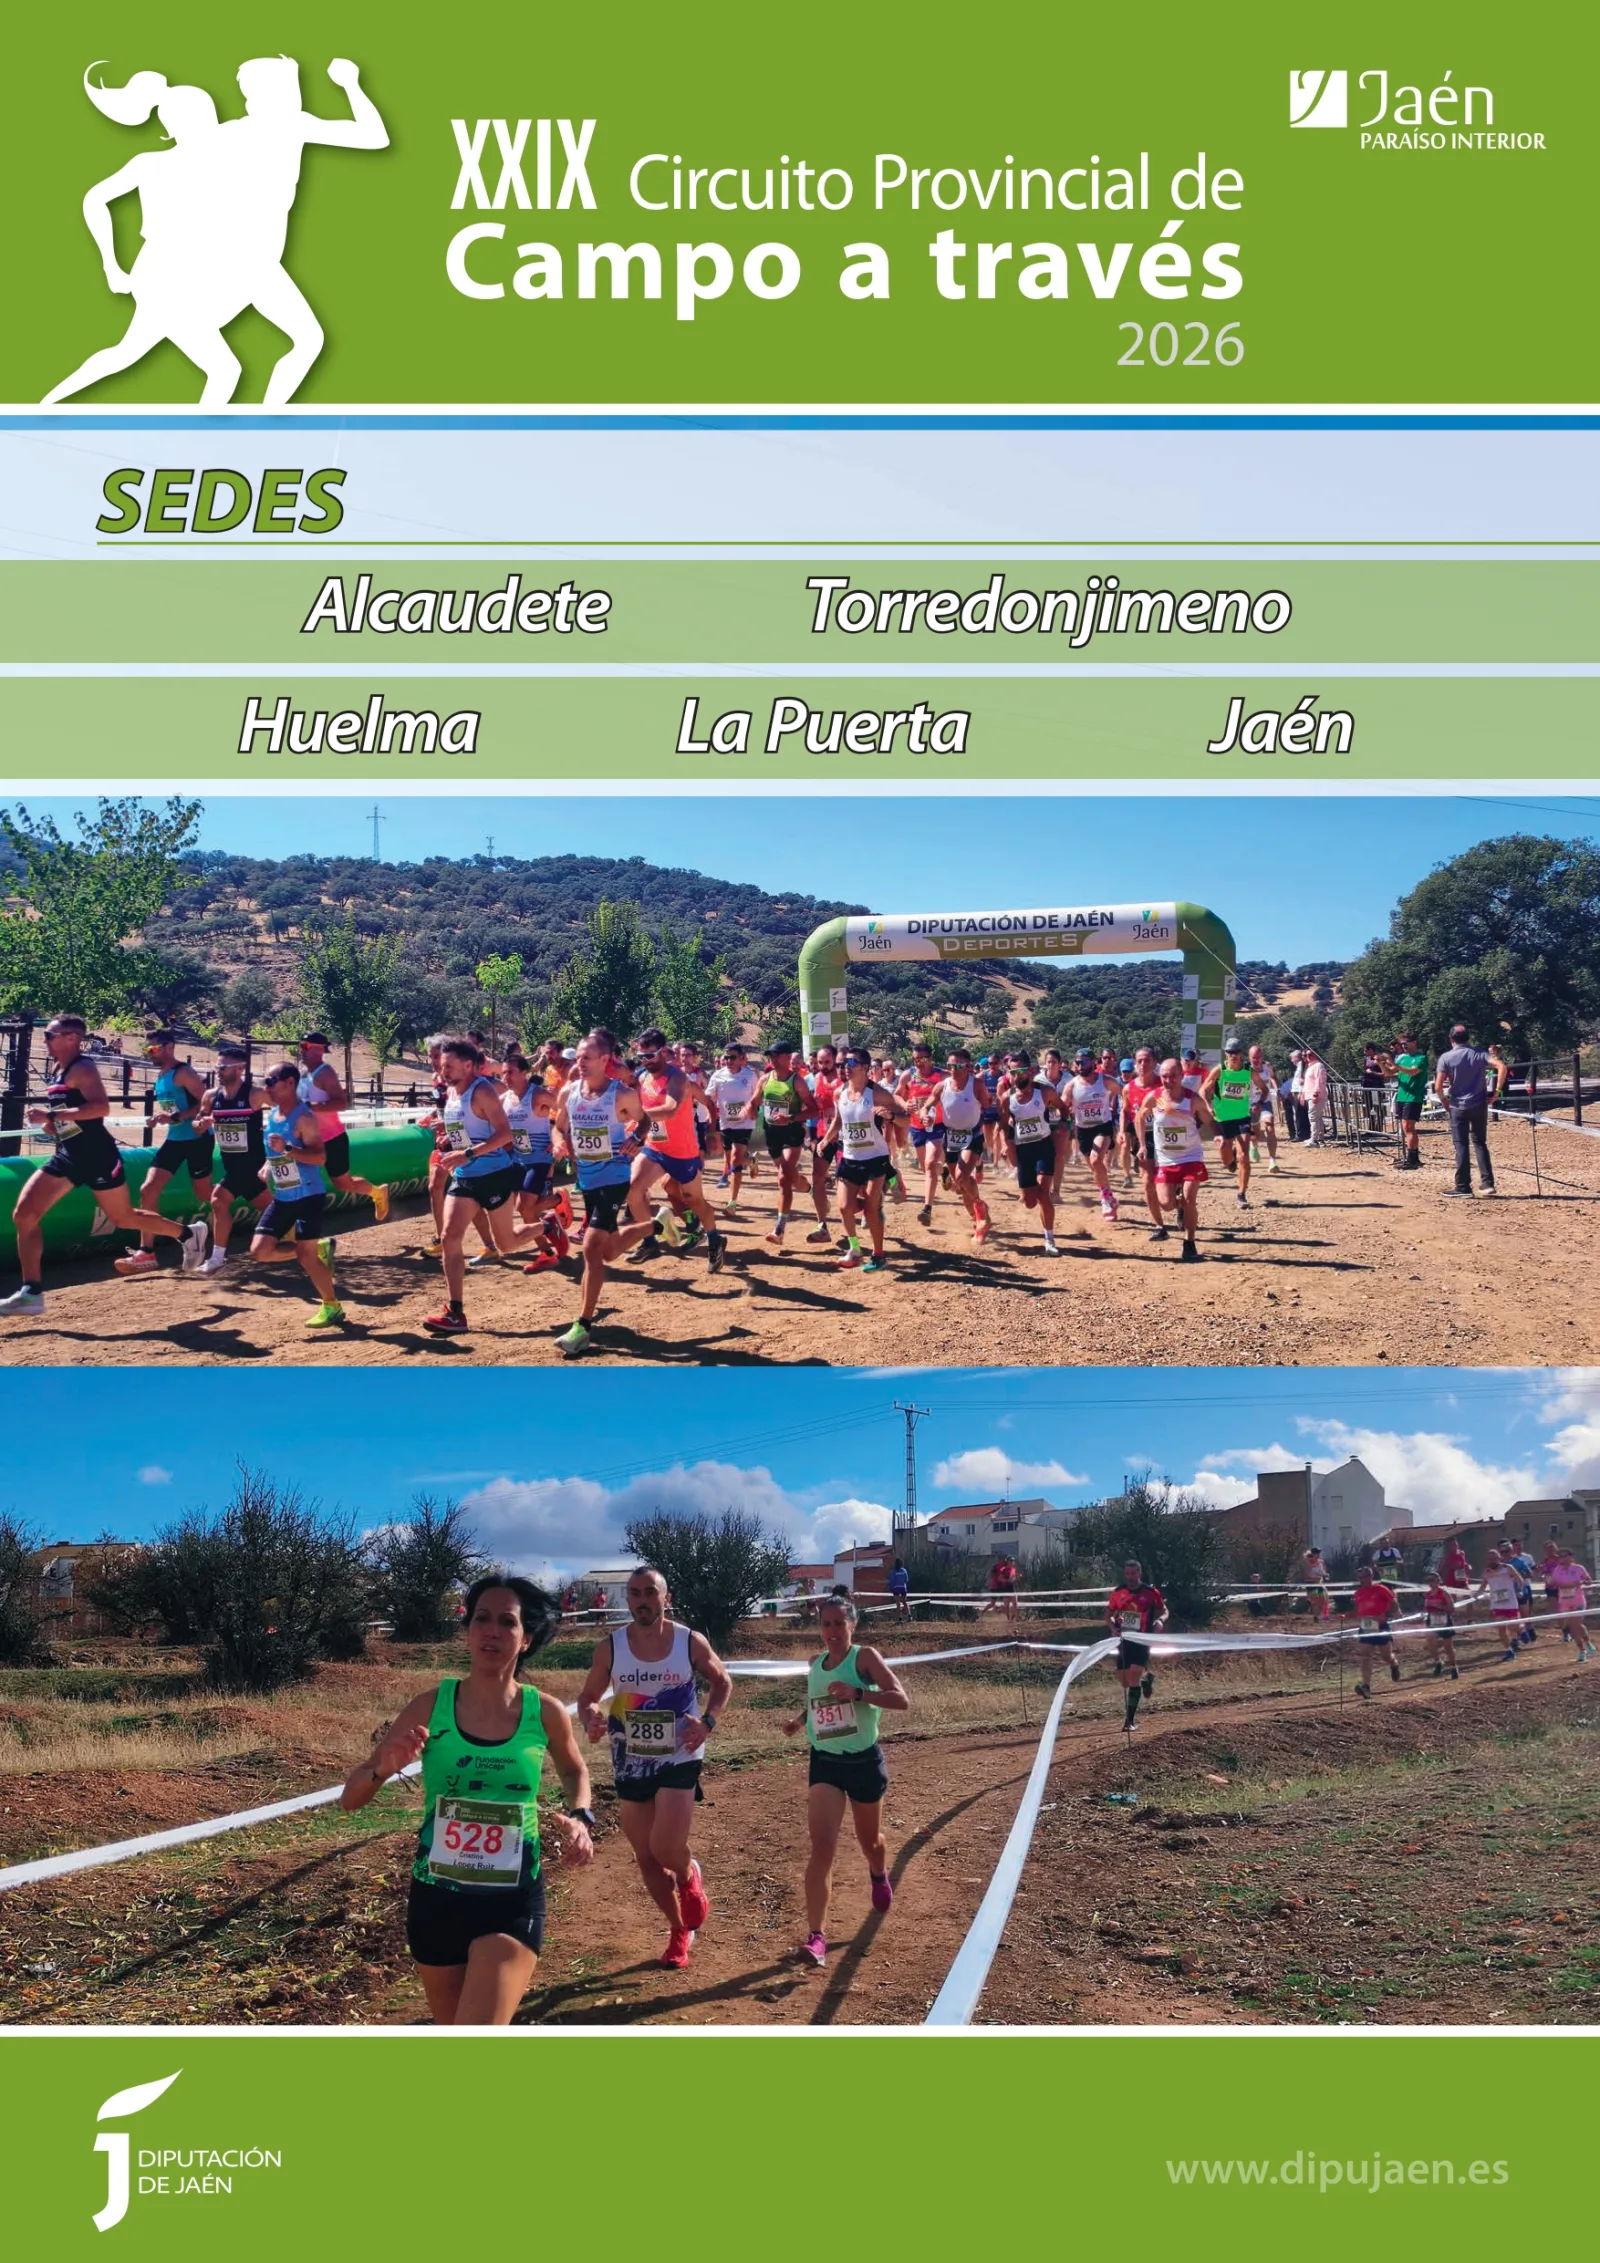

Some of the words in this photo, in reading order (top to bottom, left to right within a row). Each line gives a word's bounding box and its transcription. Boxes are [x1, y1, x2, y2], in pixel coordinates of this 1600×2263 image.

[1359, 70, 1493, 127] Jaén
[1361, 131, 1446, 149] PARAÍSO
[1452, 133, 1546, 149] INTERIOR
[451, 119, 597, 209] XXIX
[630, 154, 853, 210] Circuito
[876, 152, 1148, 210] Provincial
[1171, 152, 1244, 210] de
[446, 222, 800, 320] Campo
[840, 242, 890, 299] a
[929, 221, 1243, 299] través
[1117, 322, 1244, 366] 2026
[96, 469, 347, 533] SEDES
[302, 575, 612, 633] Alcaudete
[806, 575, 1292, 648] Torredonjimeno
[238, 695, 481, 754] Huelma
[676, 697, 752, 754] La
[764, 697, 971, 754] Puerta
[1207, 696, 1354, 754] Jaén
[907, 915, 1026, 934] DIPUTACIÓN
[1033, 914, 1059, 929] DE
[1063, 911, 1114, 928] JAÉN
[1132, 924, 1169, 940] Jaén
[859, 935, 892, 949] Jaén
[1225, 1086, 1241, 1095] 440
[220, 1131, 240, 1142] 183
[848, 1129, 866, 1139] 230
[950, 1135, 967, 1144] 422
[1020, 1124, 1038, 1135] 233
[1165, 1133, 1178, 1142] 50
[577, 1136, 602, 1149] 250
[619, 1668, 680, 1686] calderón
[816, 1705, 842, 1724] 351
[631, 1723, 664, 1740] 288
[475, 1756, 516, 1764] Fundación
[475, 1763, 505, 1771] Unicaja
[445, 1820, 504, 1855] 528
[138, 2147, 282, 2168] DIPUTACIÓN
[1167, 2151, 1508, 2193] www.dipujaen.es
[138, 2176, 169, 2194] DE
[175, 2173, 232, 2194] JAÉN
